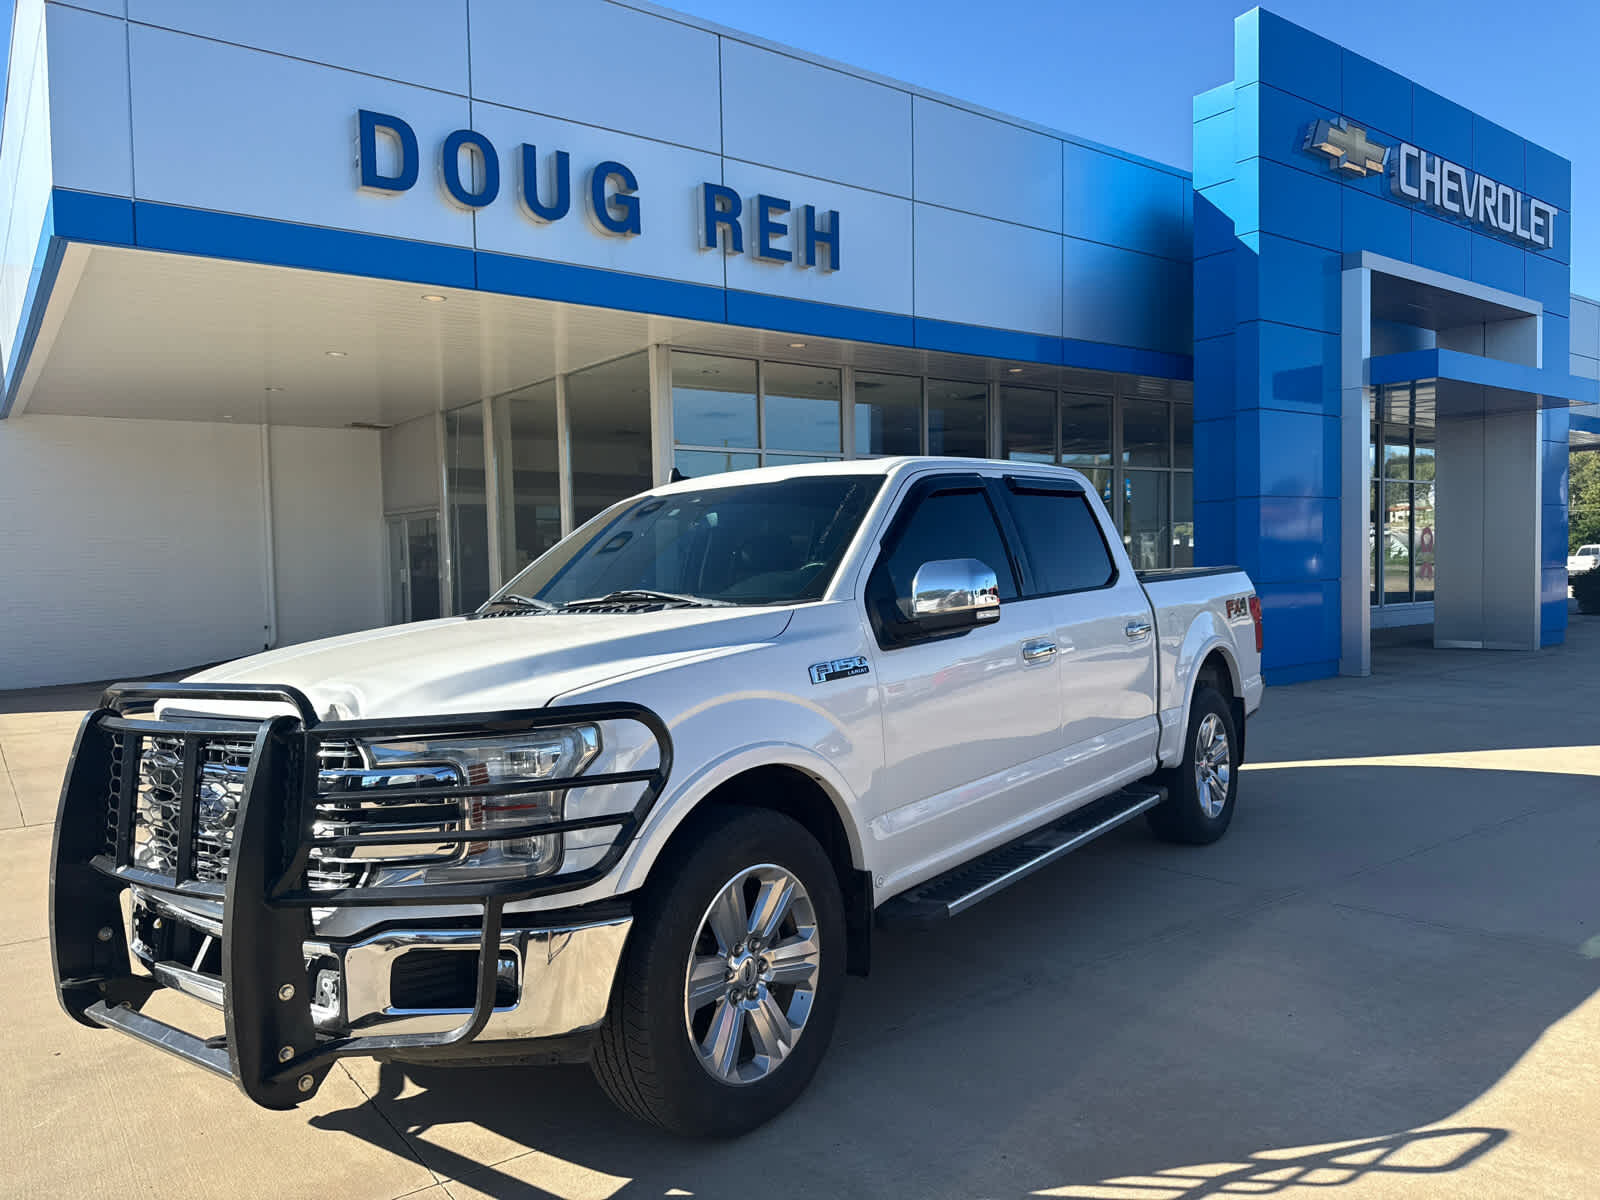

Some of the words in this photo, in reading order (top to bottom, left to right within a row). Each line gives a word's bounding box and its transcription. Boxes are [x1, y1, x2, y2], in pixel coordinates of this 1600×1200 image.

[357, 108, 642, 237] DOUG
[701, 182, 841, 272] REH
[1398, 142, 1558, 248] CHEVROLET
